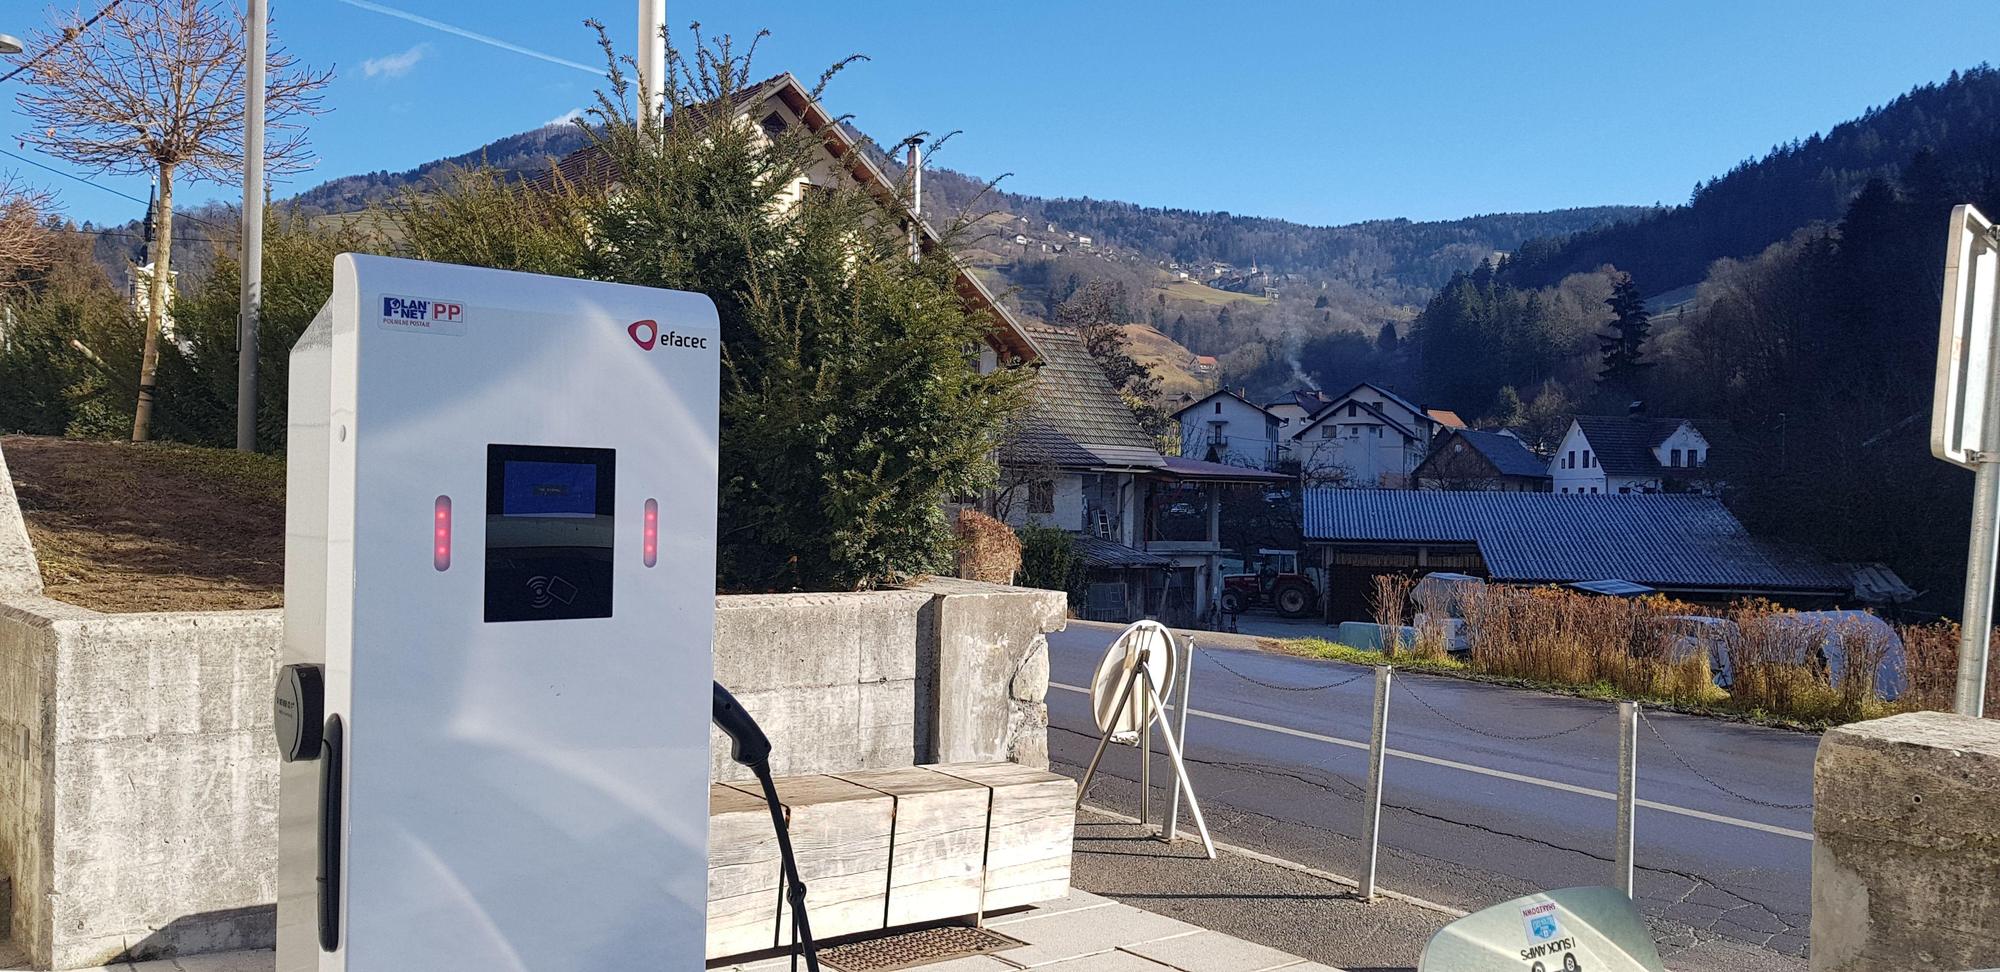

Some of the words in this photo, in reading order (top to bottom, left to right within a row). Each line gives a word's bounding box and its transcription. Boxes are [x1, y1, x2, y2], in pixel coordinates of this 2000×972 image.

[434, 303, 460, 320] PP
[661, 331, 707, 349] efacec
[1523, 903, 1556, 917] SHAKEDOWN
[1547, 938, 1571, 954] SUCK
[1572, 937, 1576, 948] I
[1521, 944, 1546, 960] AMPS
